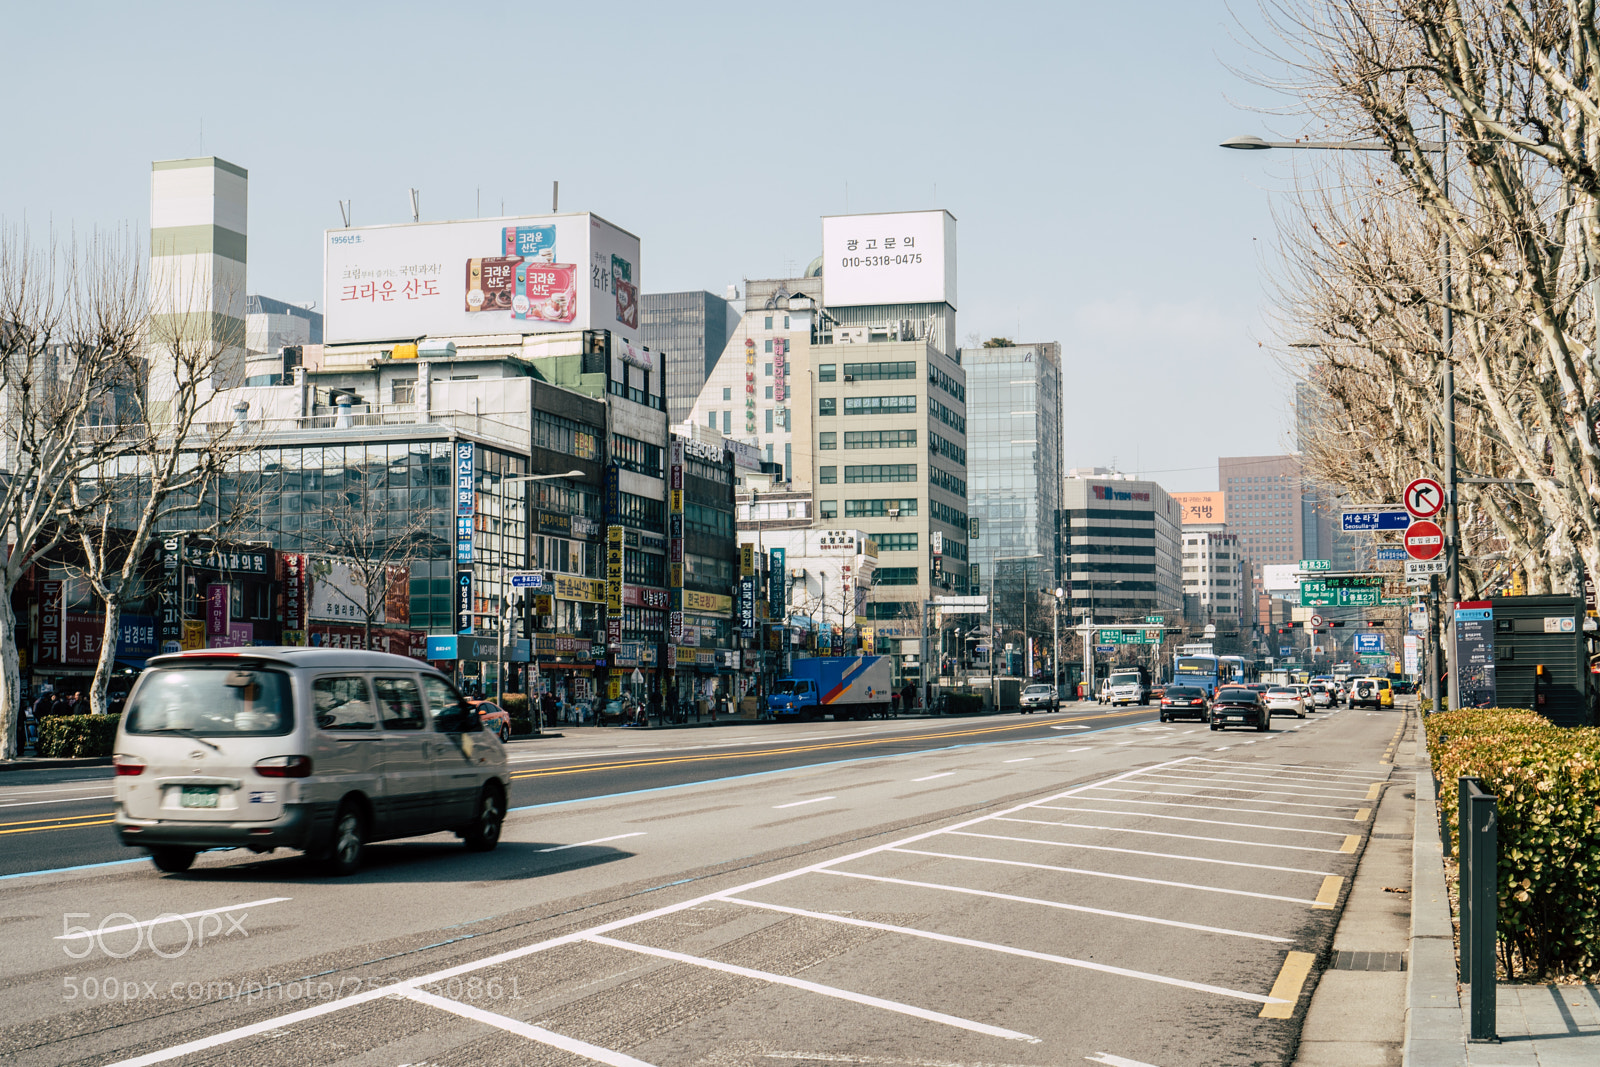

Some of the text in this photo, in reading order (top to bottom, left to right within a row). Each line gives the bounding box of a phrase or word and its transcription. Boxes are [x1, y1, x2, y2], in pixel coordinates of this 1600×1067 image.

[518, 232, 543, 243] 크라운
[521, 243, 537, 253] 산도
[842, 253, 922, 268] 010-5318-0475
[399, 264, 442, 276] 국민과자!
[484, 265, 511, 277] 크라운
[487, 277, 504, 288] 산도
[529, 272, 556, 285] 크라운
[341, 278, 440, 302] 크라운 산도
[532, 284, 549, 296] 산도
[459, 446, 472, 505] 창신과학
[1190, 505, 1213, 518] 직방
[1345, 513, 1379, 523] 서순라길
[1302, 561, 1329, 569] 종로3가
[1410, 563, 1443, 572] 일방통행
[688, 591, 717, 608] 한국보청기
[742, 582, 752, 628] 한국보청기
